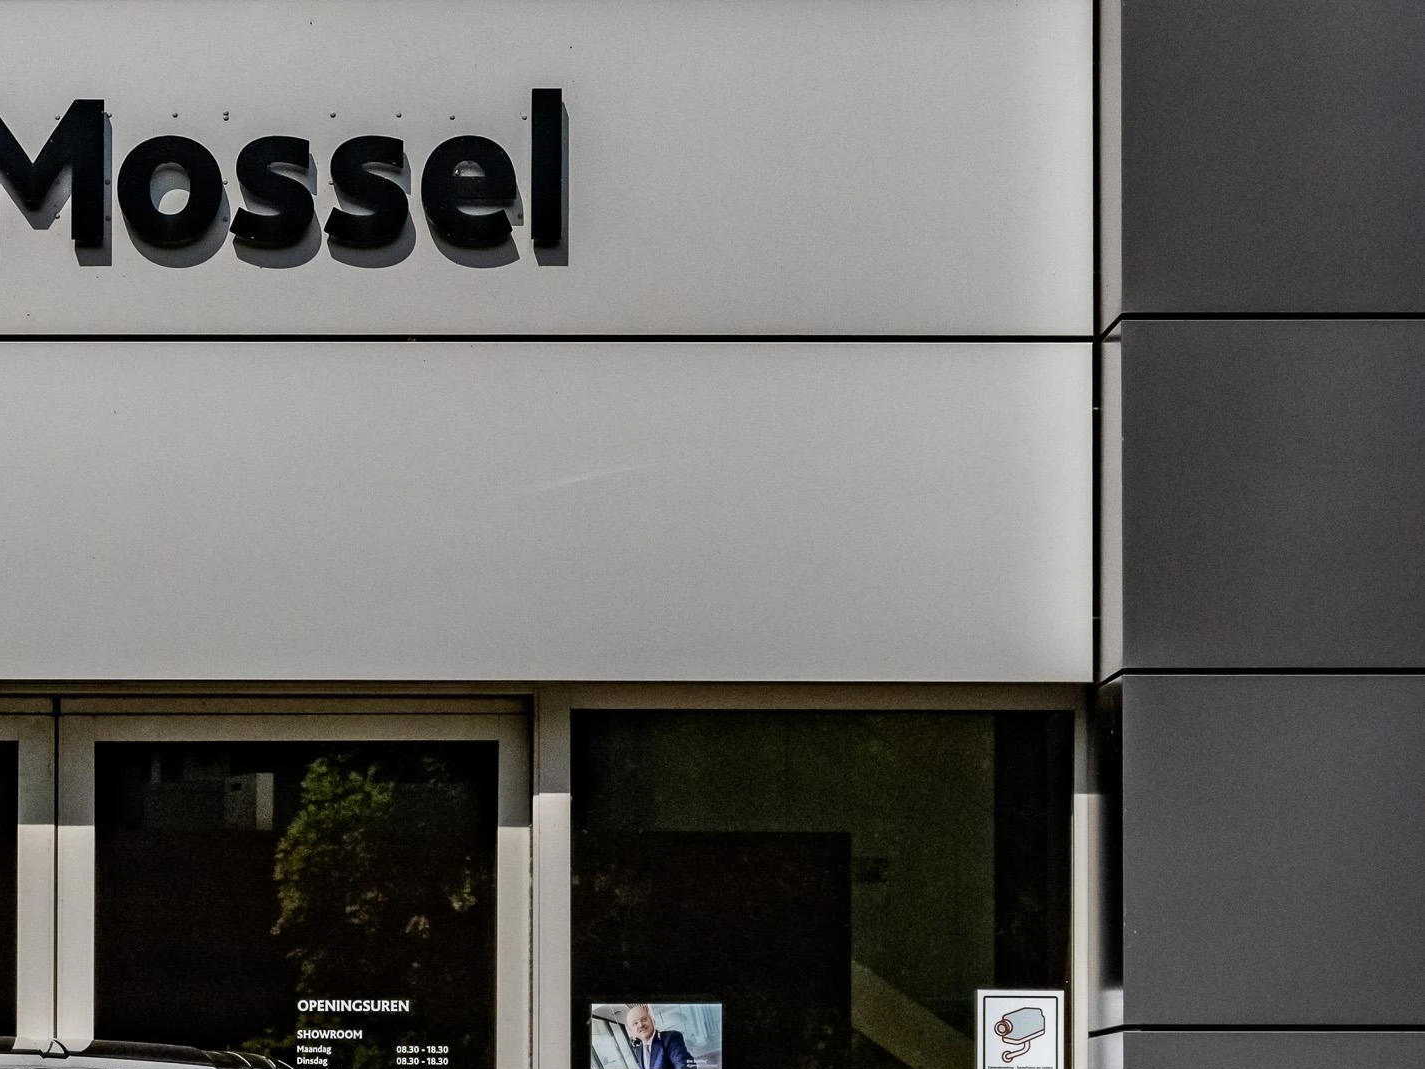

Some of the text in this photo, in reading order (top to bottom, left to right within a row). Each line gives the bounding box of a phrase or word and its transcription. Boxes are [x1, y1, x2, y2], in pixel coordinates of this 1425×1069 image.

[297, 999, 410, 1012] OPENINGSUREN
[296, 1029, 363, 1040] SHOWROOM
[296, 1045, 332, 1055] Maandag
[396, 1046, 420, 1054] 08.30
[426, 1046, 449, 1054] 18.30
[296, 1056, 329, 1067] Dinsdag
[396, 1057, 420, 1065] 08.30
[426, 1057, 449, 1065] 18.30
